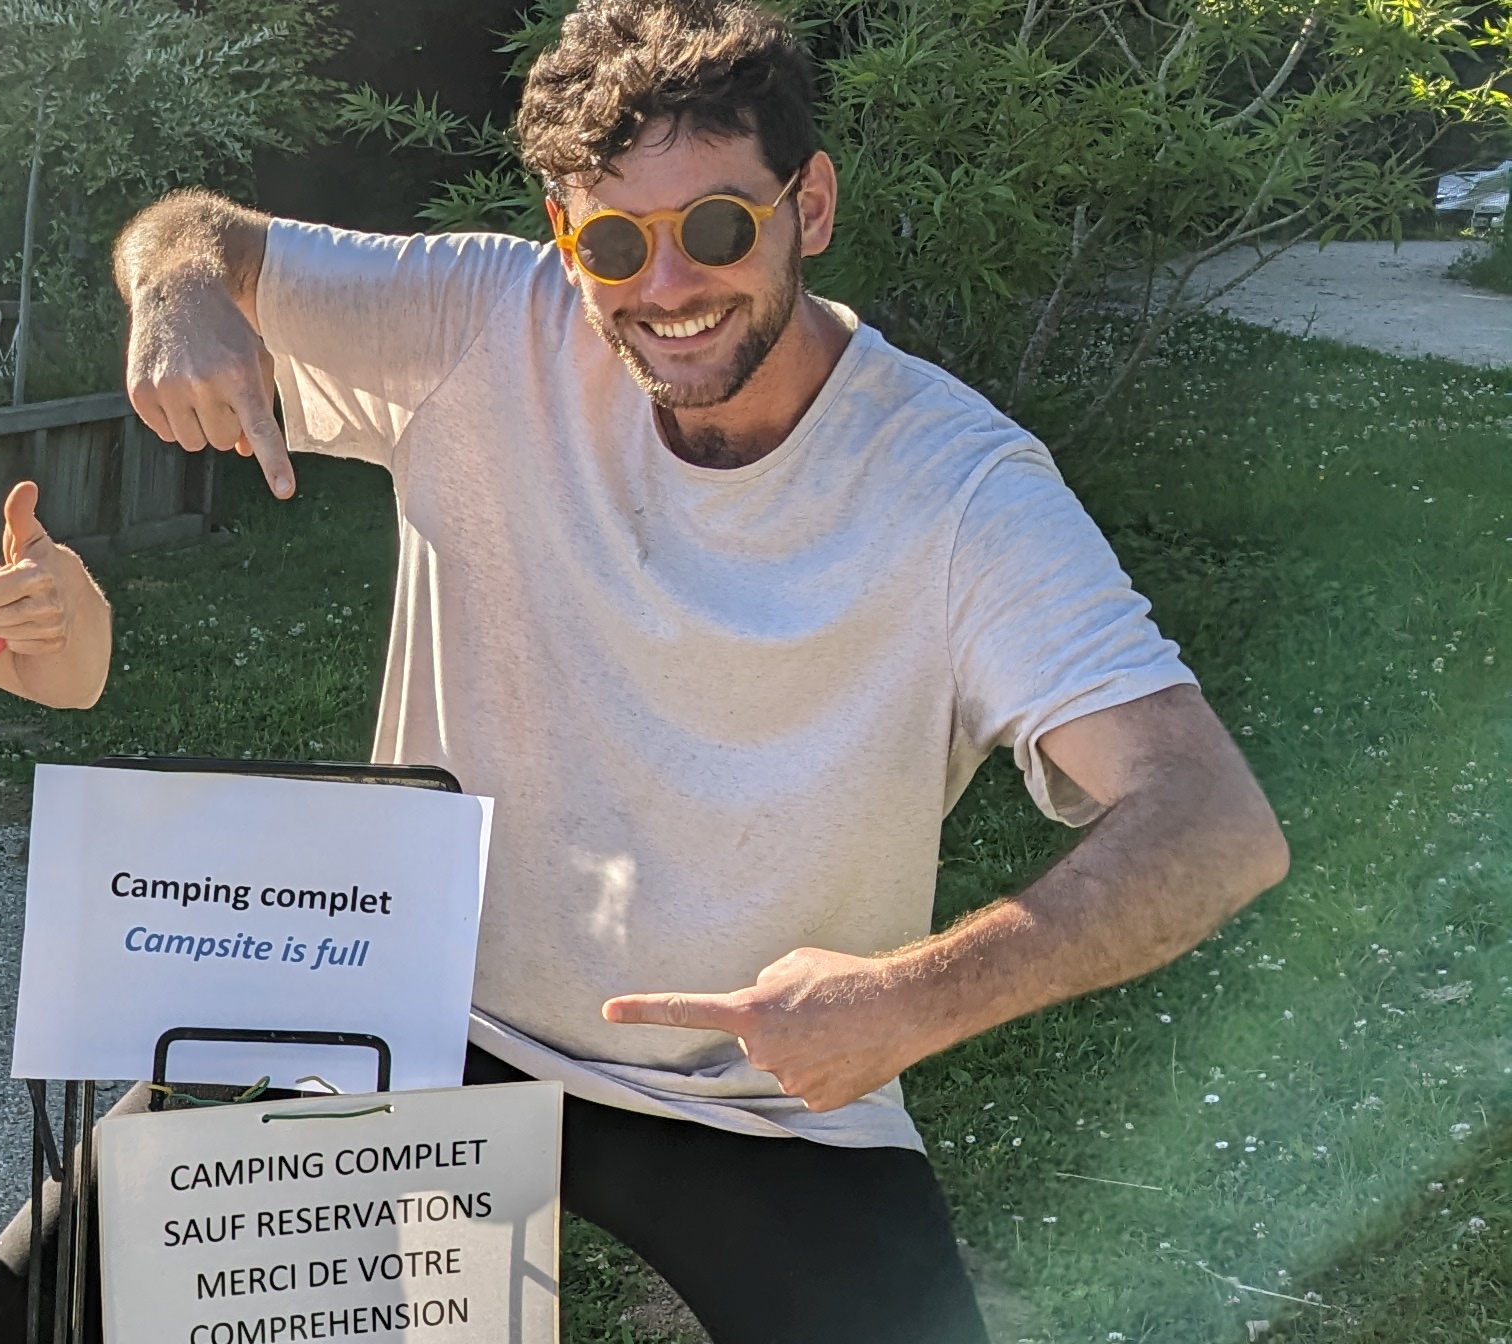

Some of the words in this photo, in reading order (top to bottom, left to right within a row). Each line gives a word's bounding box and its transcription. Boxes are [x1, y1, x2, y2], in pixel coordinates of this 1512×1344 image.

[110, 871, 252, 912] Camping
[260, 885, 393, 918] complet
[125, 926, 274, 962] Campsite
[282, 936, 307, 964] is
[308, 937, 370, 971] full
[170, 1152, 324, 1191] CAMPING
[335, 1138, 489, 1177] COMPLET
[163, 1213, 246, 1247] SAUF
[257, 1191, 493, 1239] RESERVATIONS
[197, 1263, 296, 1300] MERCI
[308, 1258, 349, 1288] DE
[357, 1247, 461, 1284] VOTRE
